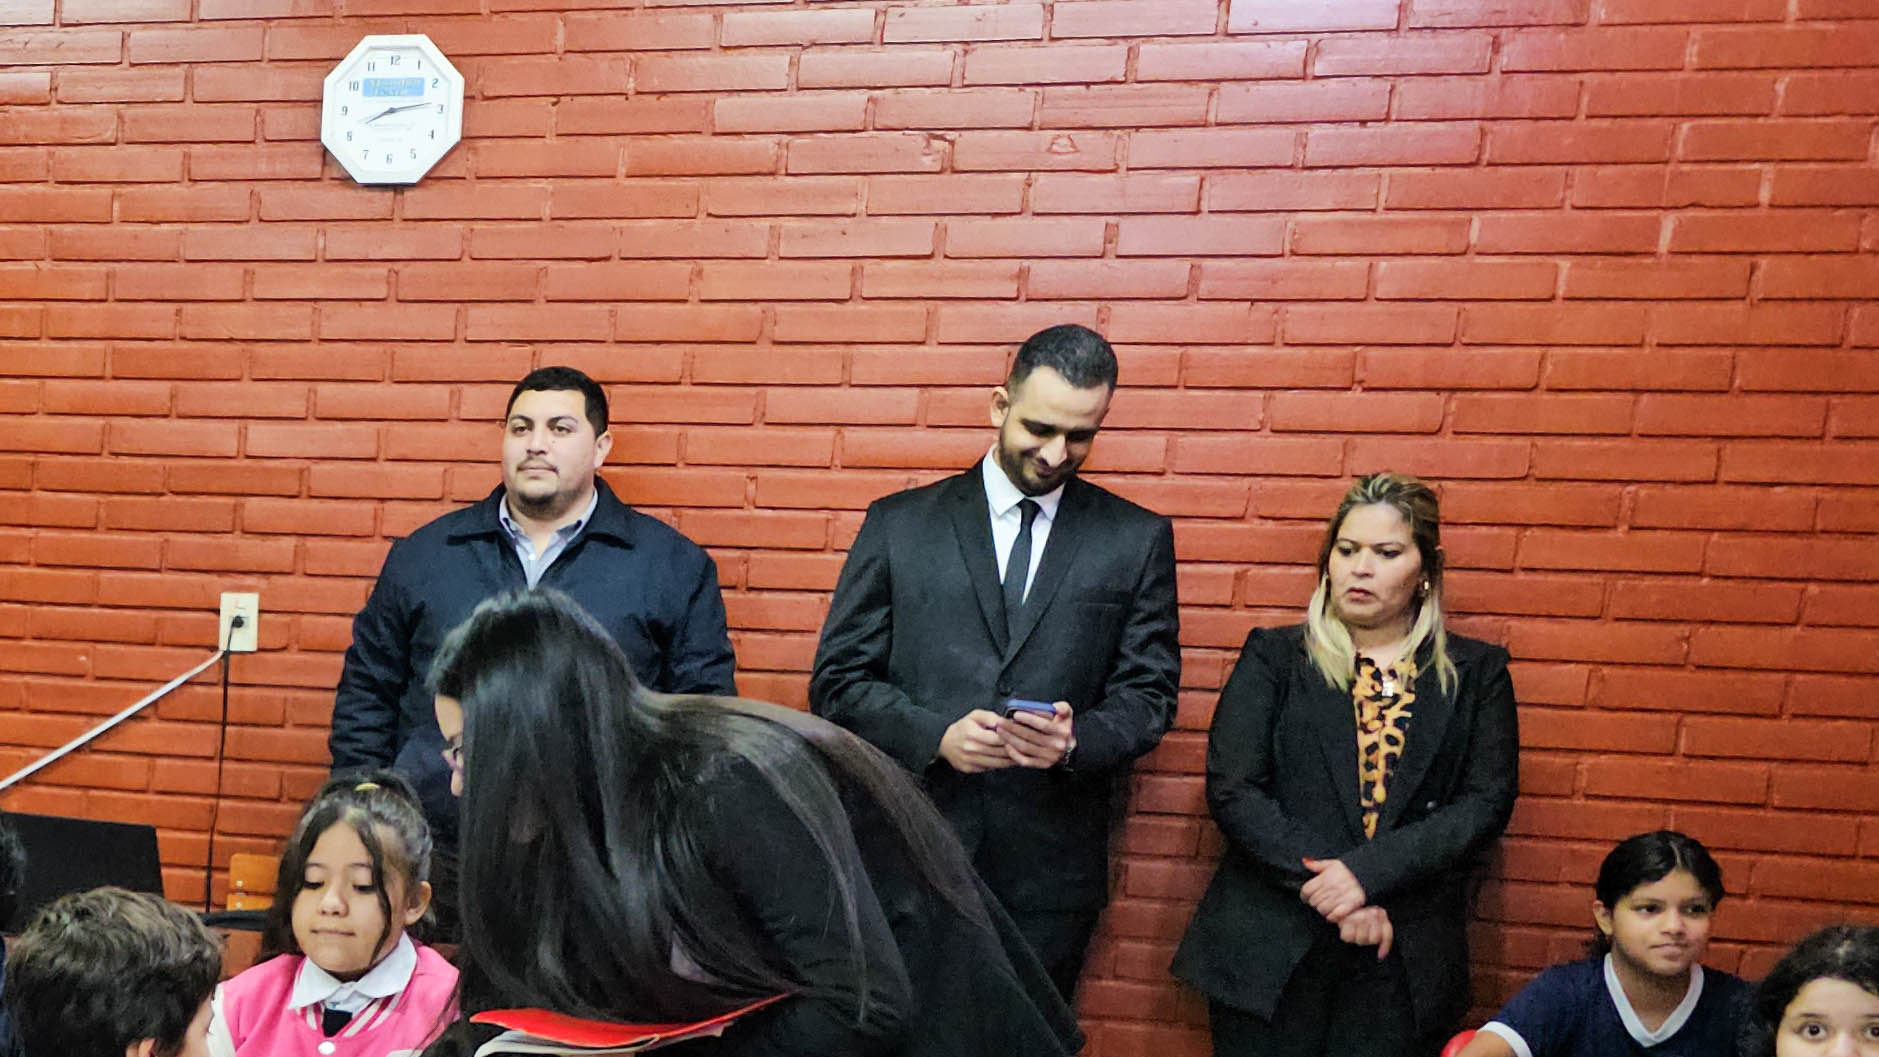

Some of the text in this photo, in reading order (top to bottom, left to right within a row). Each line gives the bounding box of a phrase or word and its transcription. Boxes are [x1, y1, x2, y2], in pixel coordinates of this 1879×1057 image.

[390, 55, 401, 66] 12
[367, 62, 376, 72] 11
[348, 81, 359, 91] 10
[431, 78, 439, 88] 2
[341, 106, 348, 116] 9
[437, 104, 444, 114] 3
[346, 131, 353, 141] 8
[428, 129, 435, 140] 4
[362, 149, 369, 160] 7
[386, 154, 393, 164] 6
[409, 149, 417, 160] 5
